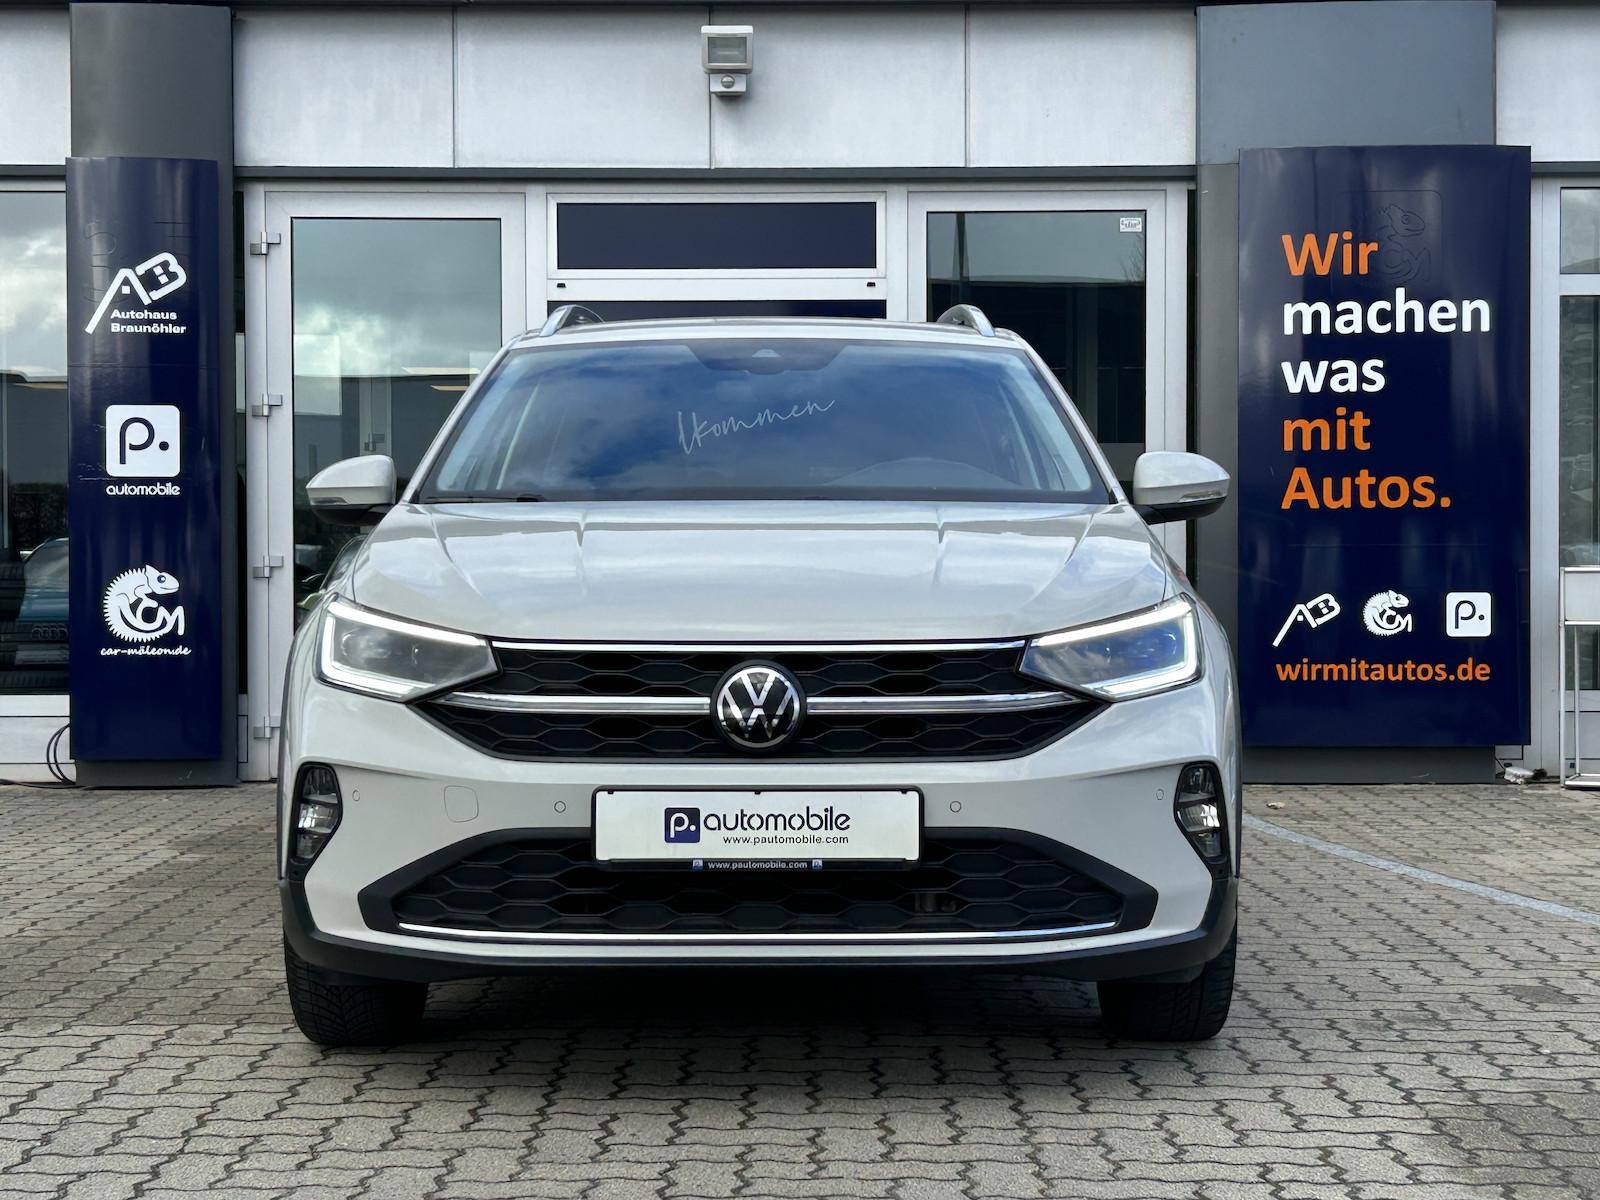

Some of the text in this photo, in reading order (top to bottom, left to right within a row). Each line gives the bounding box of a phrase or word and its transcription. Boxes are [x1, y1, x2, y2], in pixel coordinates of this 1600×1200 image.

[1282, 230, 1378, 276] Wir
[110, 309, 178, 320] Autohaus
[1283, 287, 1491, 336] machen
[110, 322, 187, 334] Braunöhler
[1281, 358, 1386, 394] was
[1283, 406, 1371, 452] mit
[105, 482, 181, 496] automobile
[1281, 466, 1451, 510] Autos.
[100, 645, 192, 656] car-mäleon.de
[1275, 657, 1491, 682] wirmitautos.de
[703, 805, 851, 831] automobile
[723, 835, 849, 846] www.pautomobile.com
[707, 861, 809, 870] www.pautomobile.com
